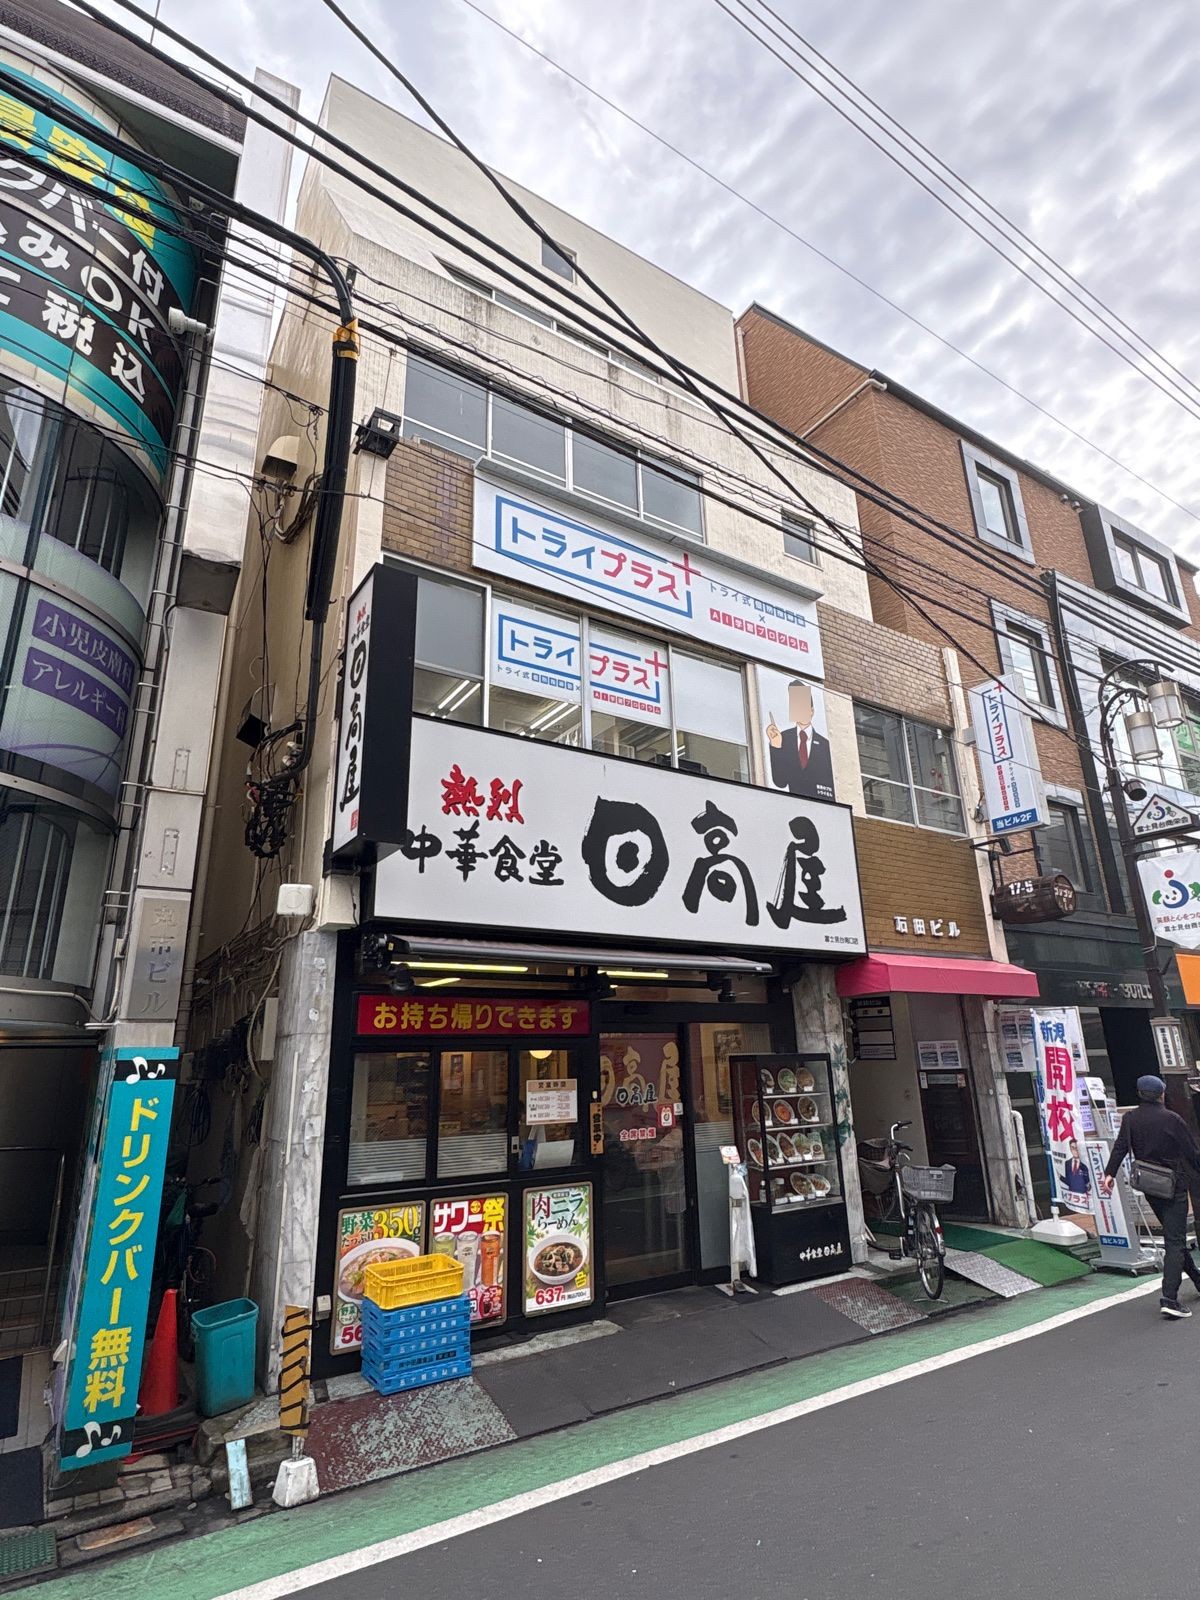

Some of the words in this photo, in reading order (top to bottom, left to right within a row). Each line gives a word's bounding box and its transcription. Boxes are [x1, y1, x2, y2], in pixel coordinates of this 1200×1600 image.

[0, 218, 155, 354] みOK
[511, 516, 680, 600] トライプラス
[440, 764, 525, 824] 熱烈
[996, 812, 1032, 829] 当ビル2F
[401, 820, 564, 886] 中華食堂
[582, 796, 847, 930] 日高屋
[1009, 880, 1034, 896] 17-5
[894, 916, 961, 938] 石田ビル
[373, 1002, 578, 1030] お持ち帰りできます
[1045, 1046, 1075, 1142] 開校
[342, 1211, 374, 1236] 野菜
[434, 1197, 505, 1233] サワー祭
[531, 1192, 584, 1221] 肉ニラ
[538, 1213, 579, 1231] らーめん
[83, 1096, 159, 1413] ドリンクバー無料
